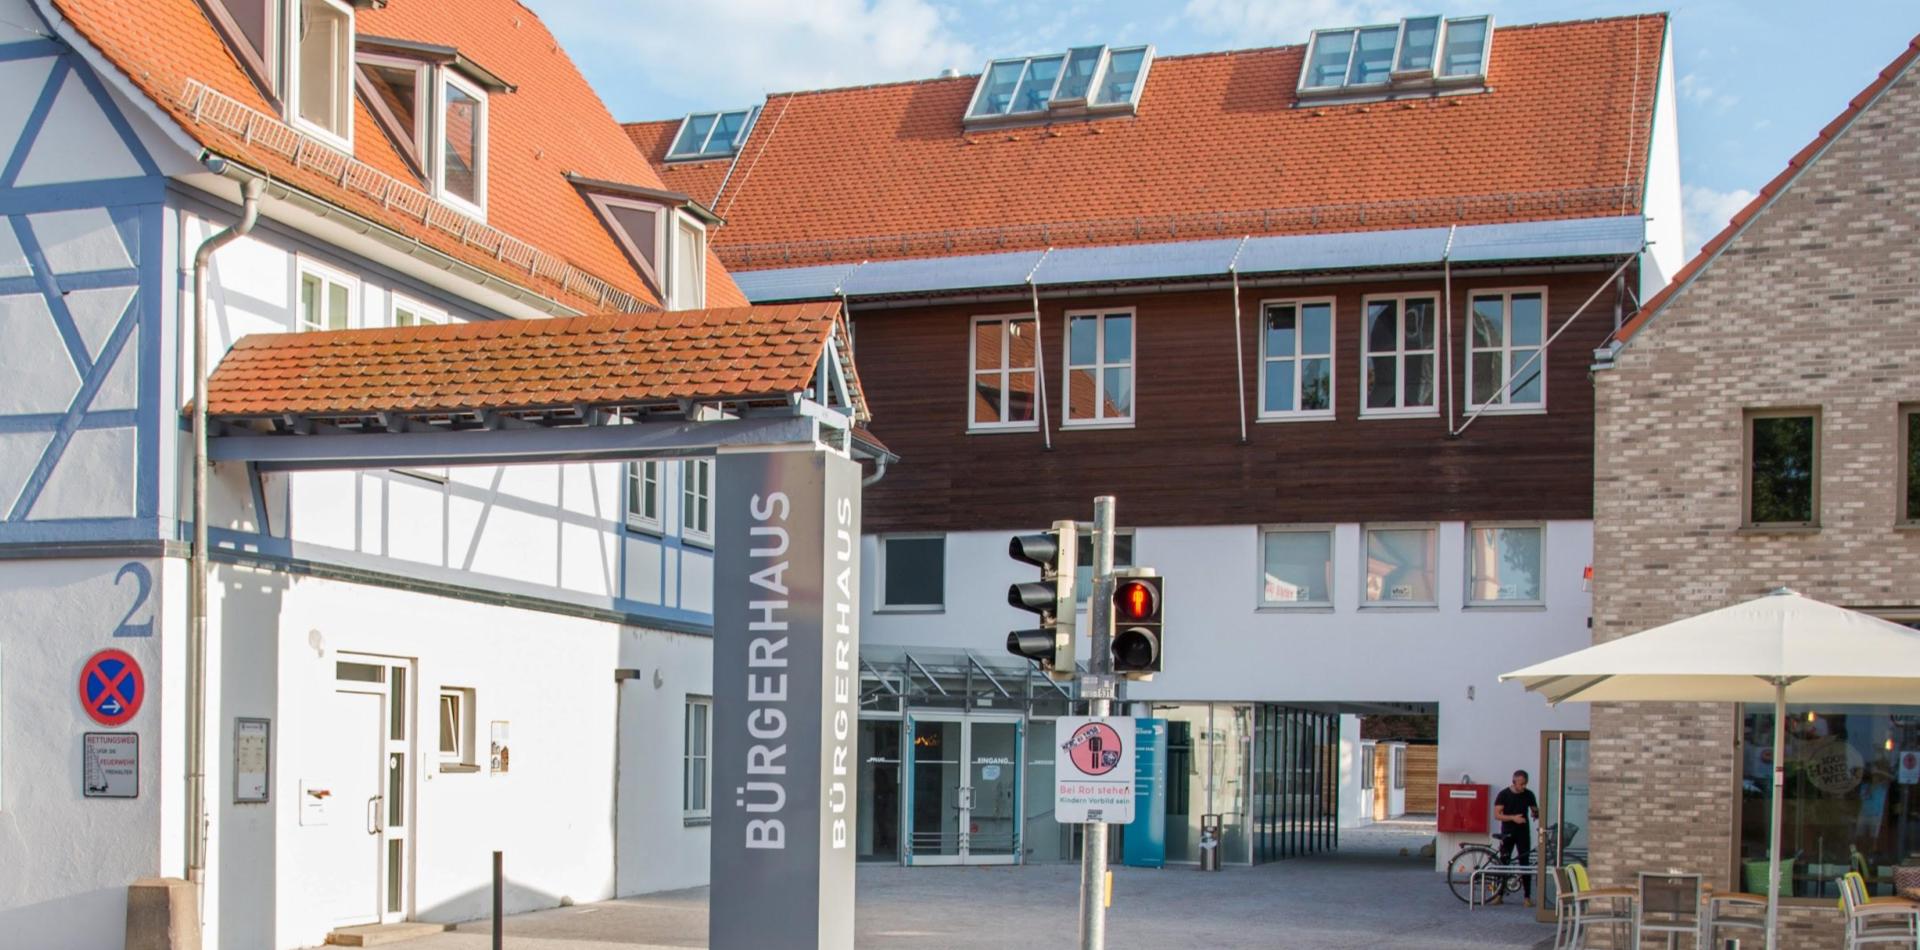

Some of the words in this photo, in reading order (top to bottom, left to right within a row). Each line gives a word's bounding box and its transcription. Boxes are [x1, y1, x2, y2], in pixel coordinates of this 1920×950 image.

[112, 561, 154, 637] 2
[736, 491, 790, 849] BÜRGERHAUS
[829, 497, 852, 849] BÜRGERHAUS
[87, 736, 135, 744] RETTUNGSWEG
[977, 756, 1008, 764] EINGANG
[1060, 785, 1076, 795] Bei
[1079, 785, 1094, 795] Rot
[1097, 786, 1130, 795] stehen
